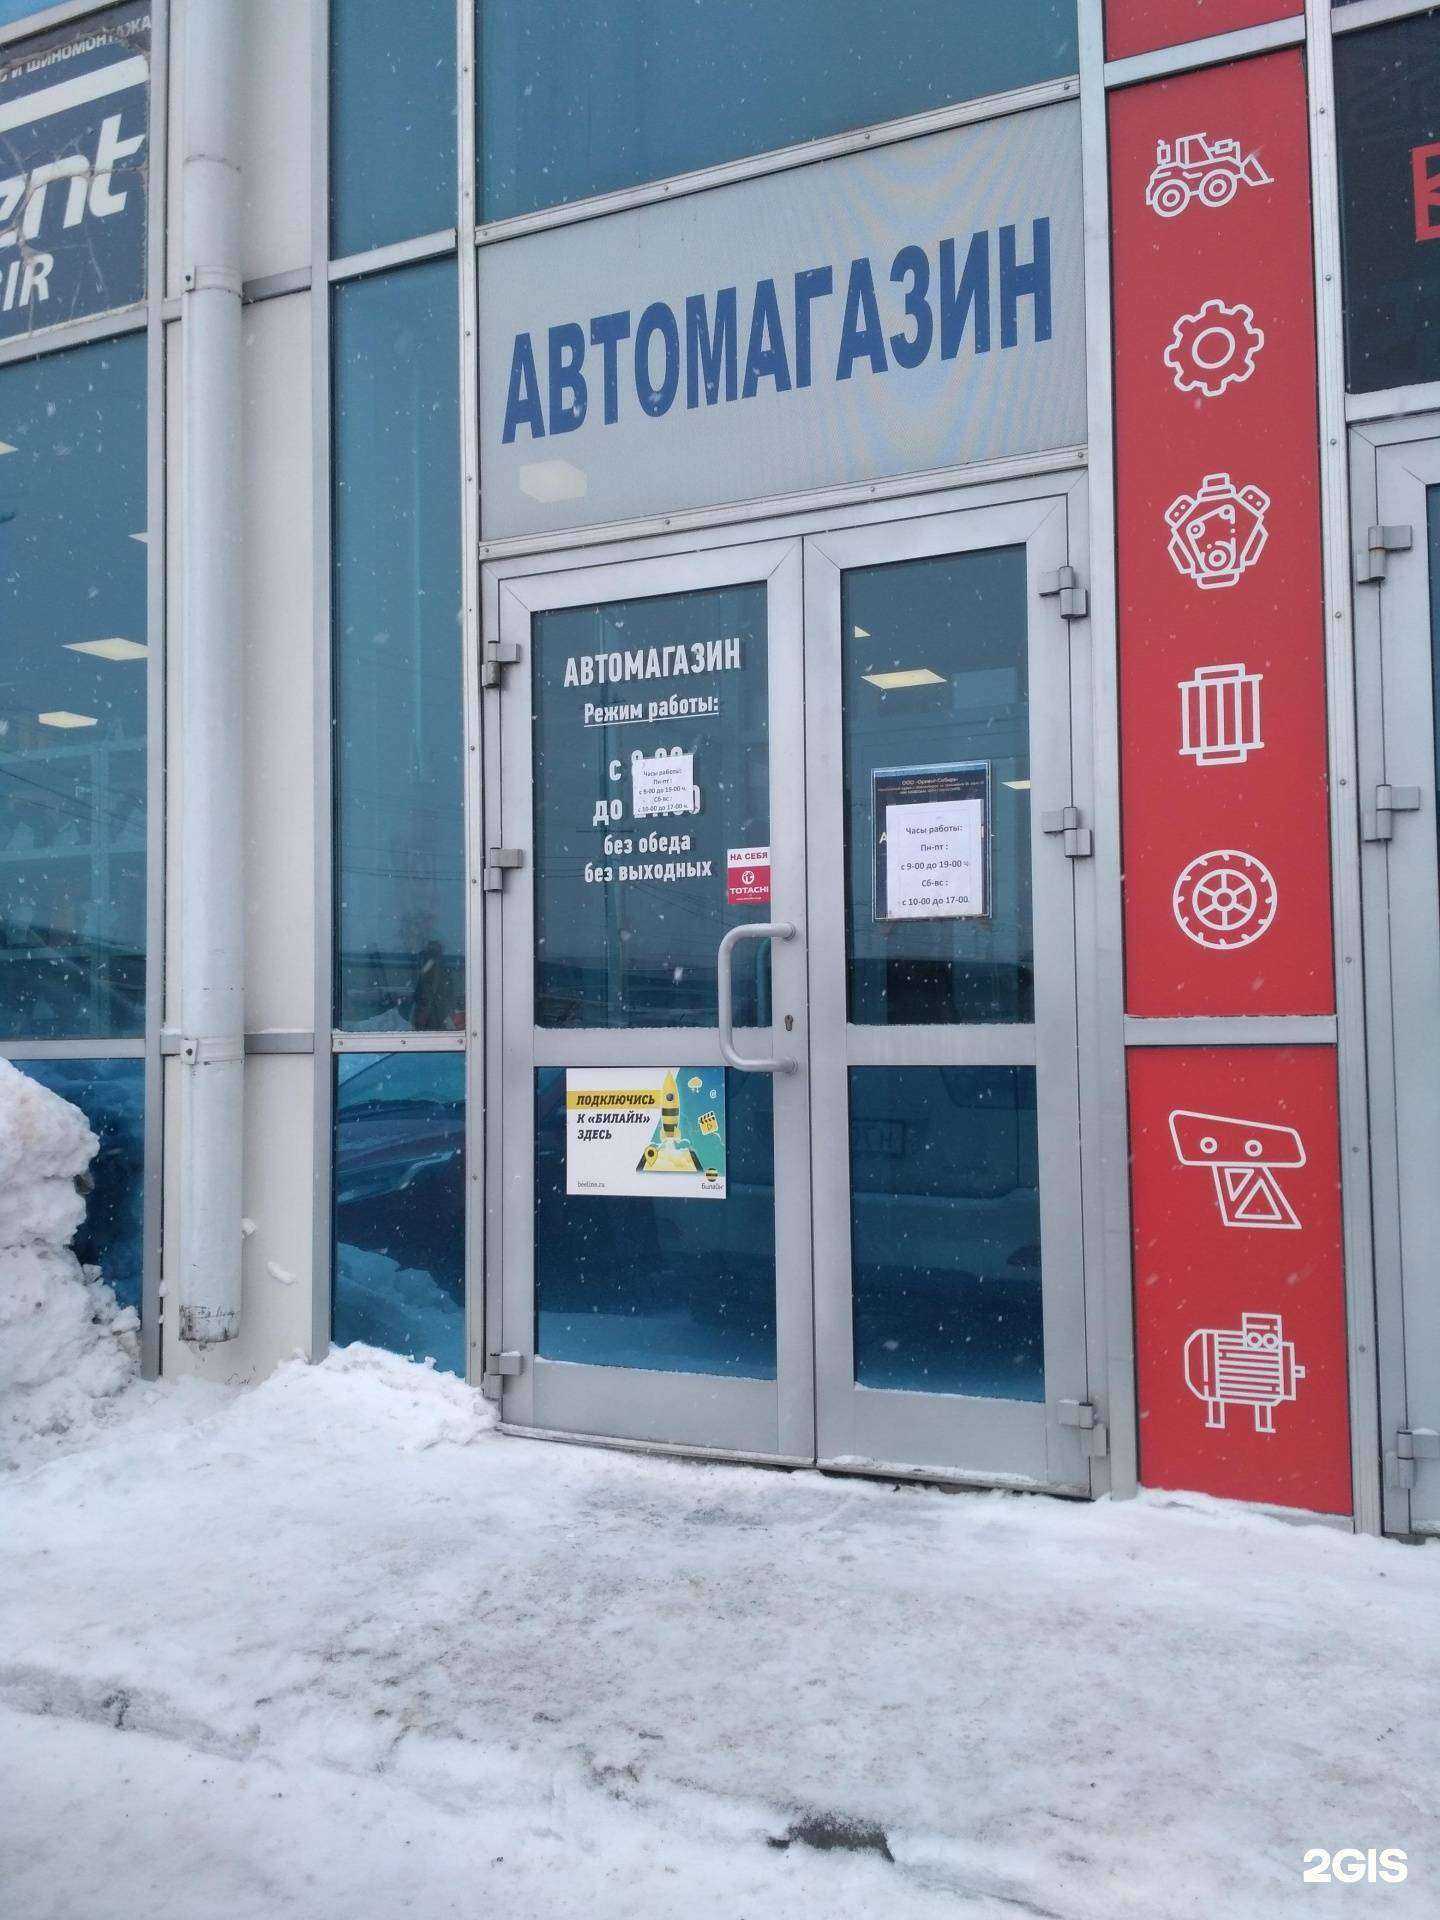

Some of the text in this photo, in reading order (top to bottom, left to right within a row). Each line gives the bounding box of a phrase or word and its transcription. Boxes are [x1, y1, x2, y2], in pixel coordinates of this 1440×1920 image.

[0, 252, 54, 312] IR
[502, 216, 1053, 444] АВТОМАГАЗИН
[563, 637, 741, 688] АВТОМАГАЗИН
[584, 694, 719, 724] Режим работы:
[592, 798, 623, 827] до
[905, 825, 963, 836] Часы работы:
[604, 831, 691, 856] без обеда
[920, 843, 944, 852] Пн-пт
[730, 851, 768, 861] НА СЕБЯ
[584, 860, 712, 883] без выходных
[906, 862, 925, 871] 9-00
[926, 863, 937, 871] до
[939, 860, 962, 869] 19-00
[921, 879, 944, 888] Сб-вс
[729, 886, 769, 895] TOTACHI
[908, 897, 931, 906] 10-00
[932, 898, 944, 907] до
[945, 896, 969, 905] 17-00
[576, 1094, 656, 1107] ПОДКЛЮЧИСЬ
[576, 1110, 651, 1125] К «БИЛАЙН»
[577, 1129, 613, 1141] ЗДЕСЬ
[577, 1180, 605, 1189] beeline.ru
